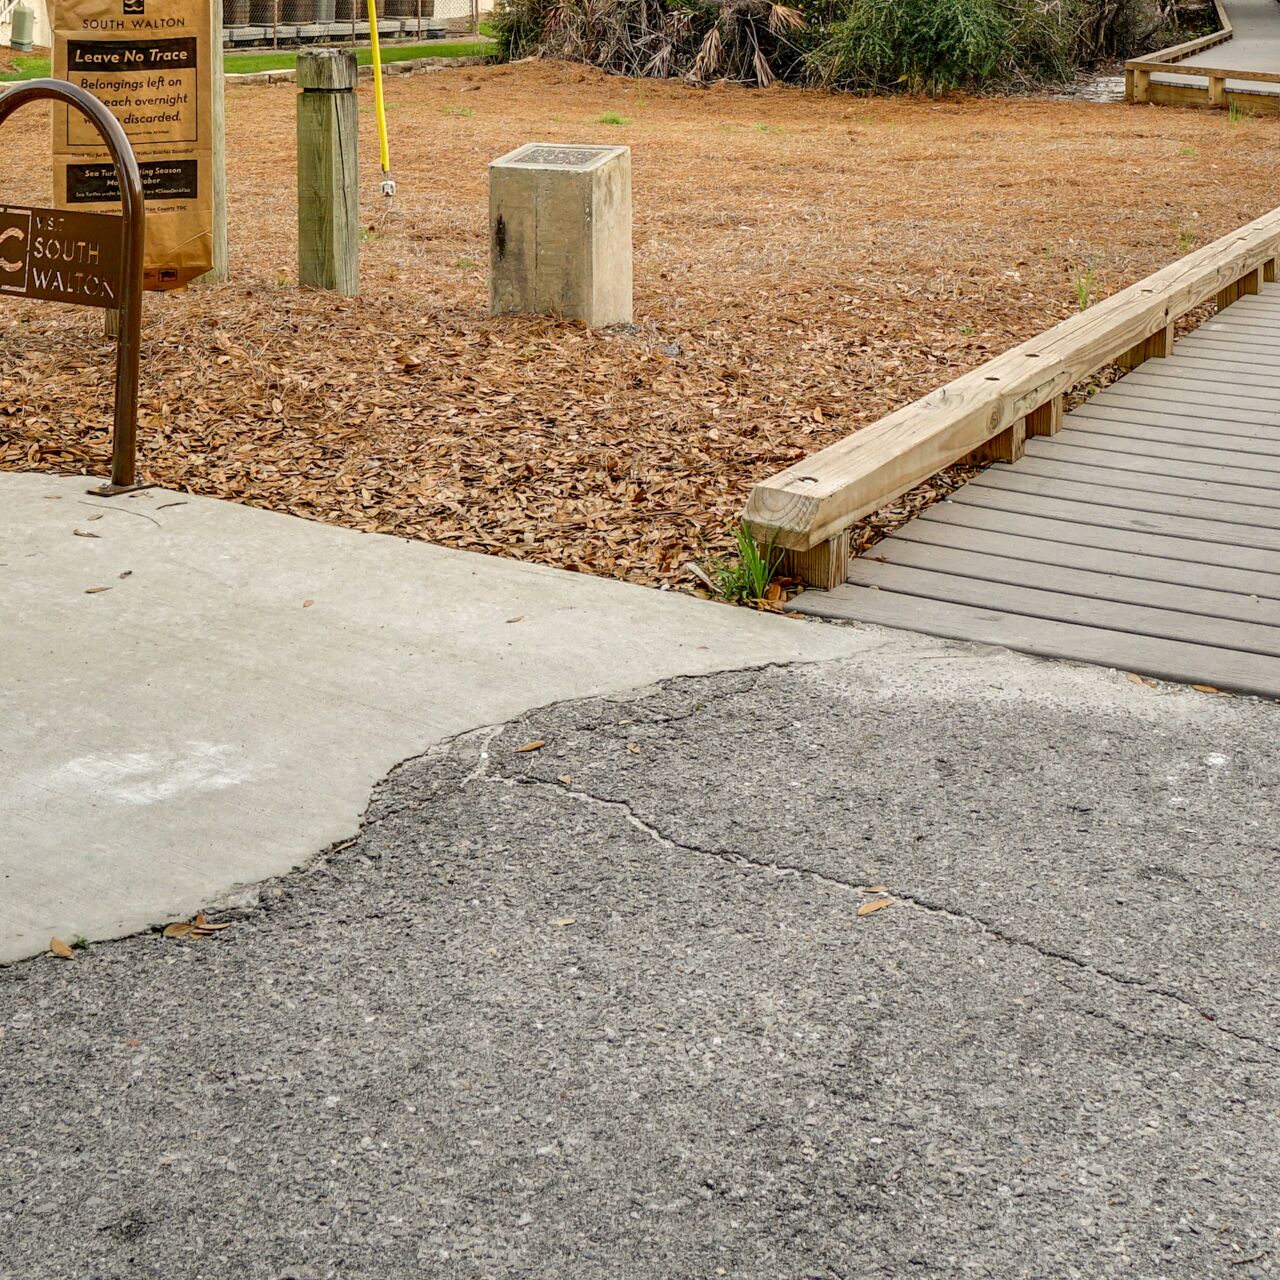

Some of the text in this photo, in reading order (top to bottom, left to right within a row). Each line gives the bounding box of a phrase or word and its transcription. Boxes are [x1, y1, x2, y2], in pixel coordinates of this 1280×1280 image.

[82, 18, 185, 30] SOUTH WALTON
[75, 49, 188, 63] Leave No Trace
[80, 79, 143, 91] Belongings
[147, 76, 164, 89] left
[98, 94, 188, 107] each overnight
[124, 111, 182, 124] discarded.
[140, 168, 153, 177] ting
[36, 217, 65, 231] VST
[33, 237, 100, 264] SOUTH
[33, 268, 114, 298] WALTON
